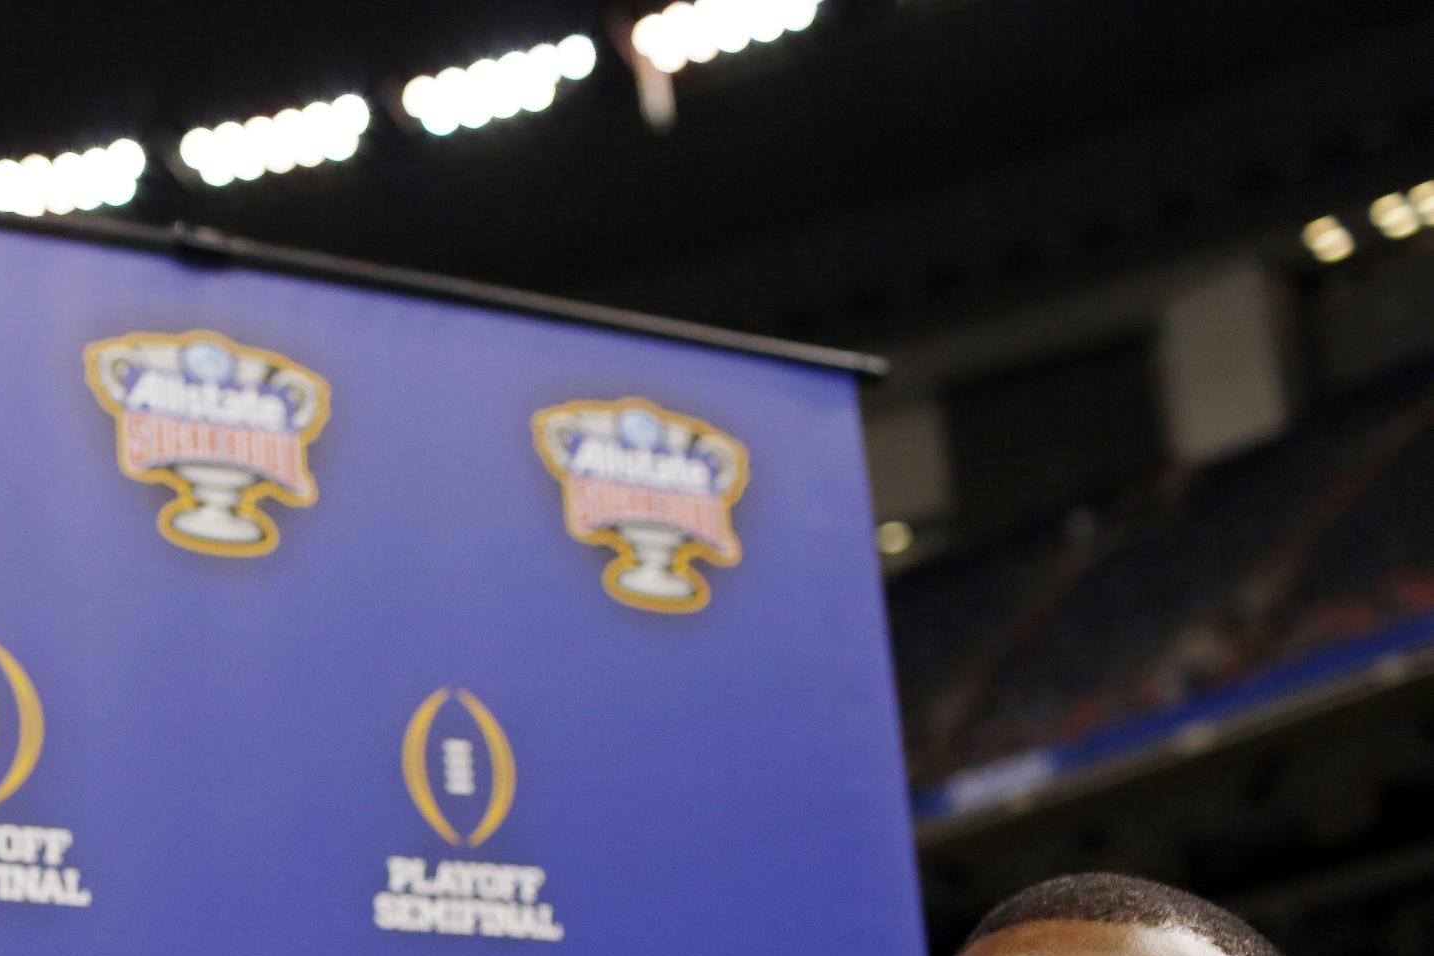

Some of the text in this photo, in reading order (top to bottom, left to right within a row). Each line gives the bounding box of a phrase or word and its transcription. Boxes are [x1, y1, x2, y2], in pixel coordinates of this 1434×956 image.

[126, 368, 287, 431] Allstate
[387, 855, 546, 904] PLAYOFF
[373, 890, 564, 942] SEMIFINAL
